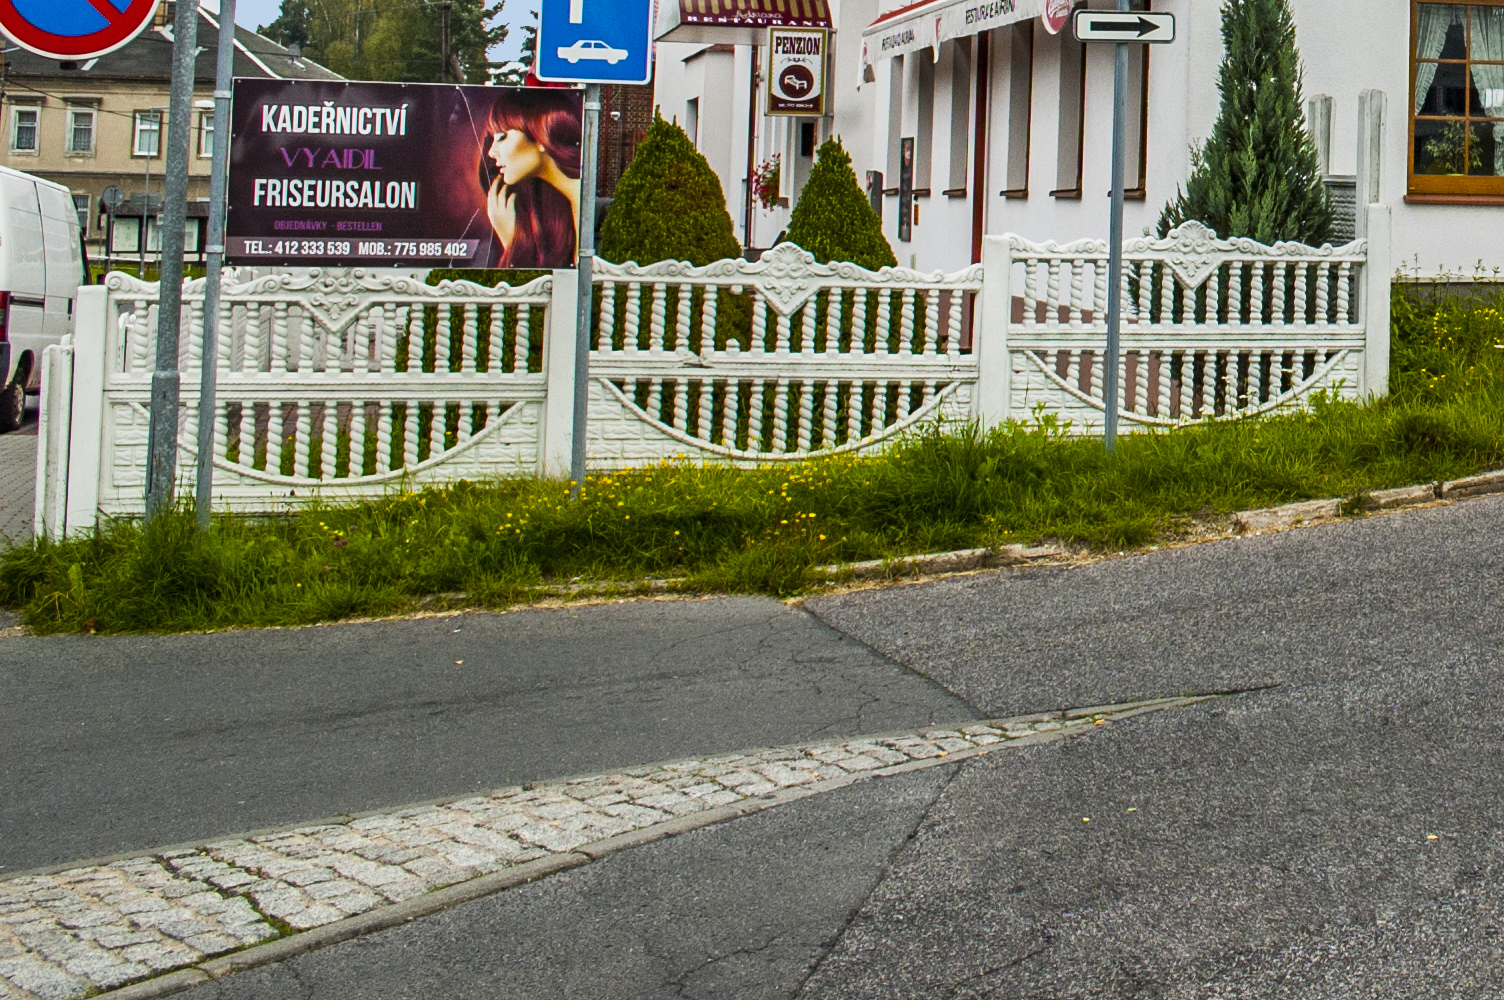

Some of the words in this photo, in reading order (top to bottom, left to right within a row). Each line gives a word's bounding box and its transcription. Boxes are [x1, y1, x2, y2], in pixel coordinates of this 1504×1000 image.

[687, 16, 827, 27] RESTAURANT
[775, 36, 821, 55] PENZION
[261, 100, 409, 136] KADEŘNICTVÍ
[253, 178, 416, 209] FRISEURSALON
[274, 220, 328, 231] OBJEDNÁVKY
[336, 221, 383, 231] BESTELLEN
[244, 240, 273, 255] TEL.:
[274, 240, 299, 255] 412
[300, 241, 325, 255] 333
[327, 241, 351, 256] 539
[358, 241, 392, 256] MOB.:
[394, 242, 417, 257] 775
[419, 242, 442, 257] 985
[444, 243, 468, 257] 402
